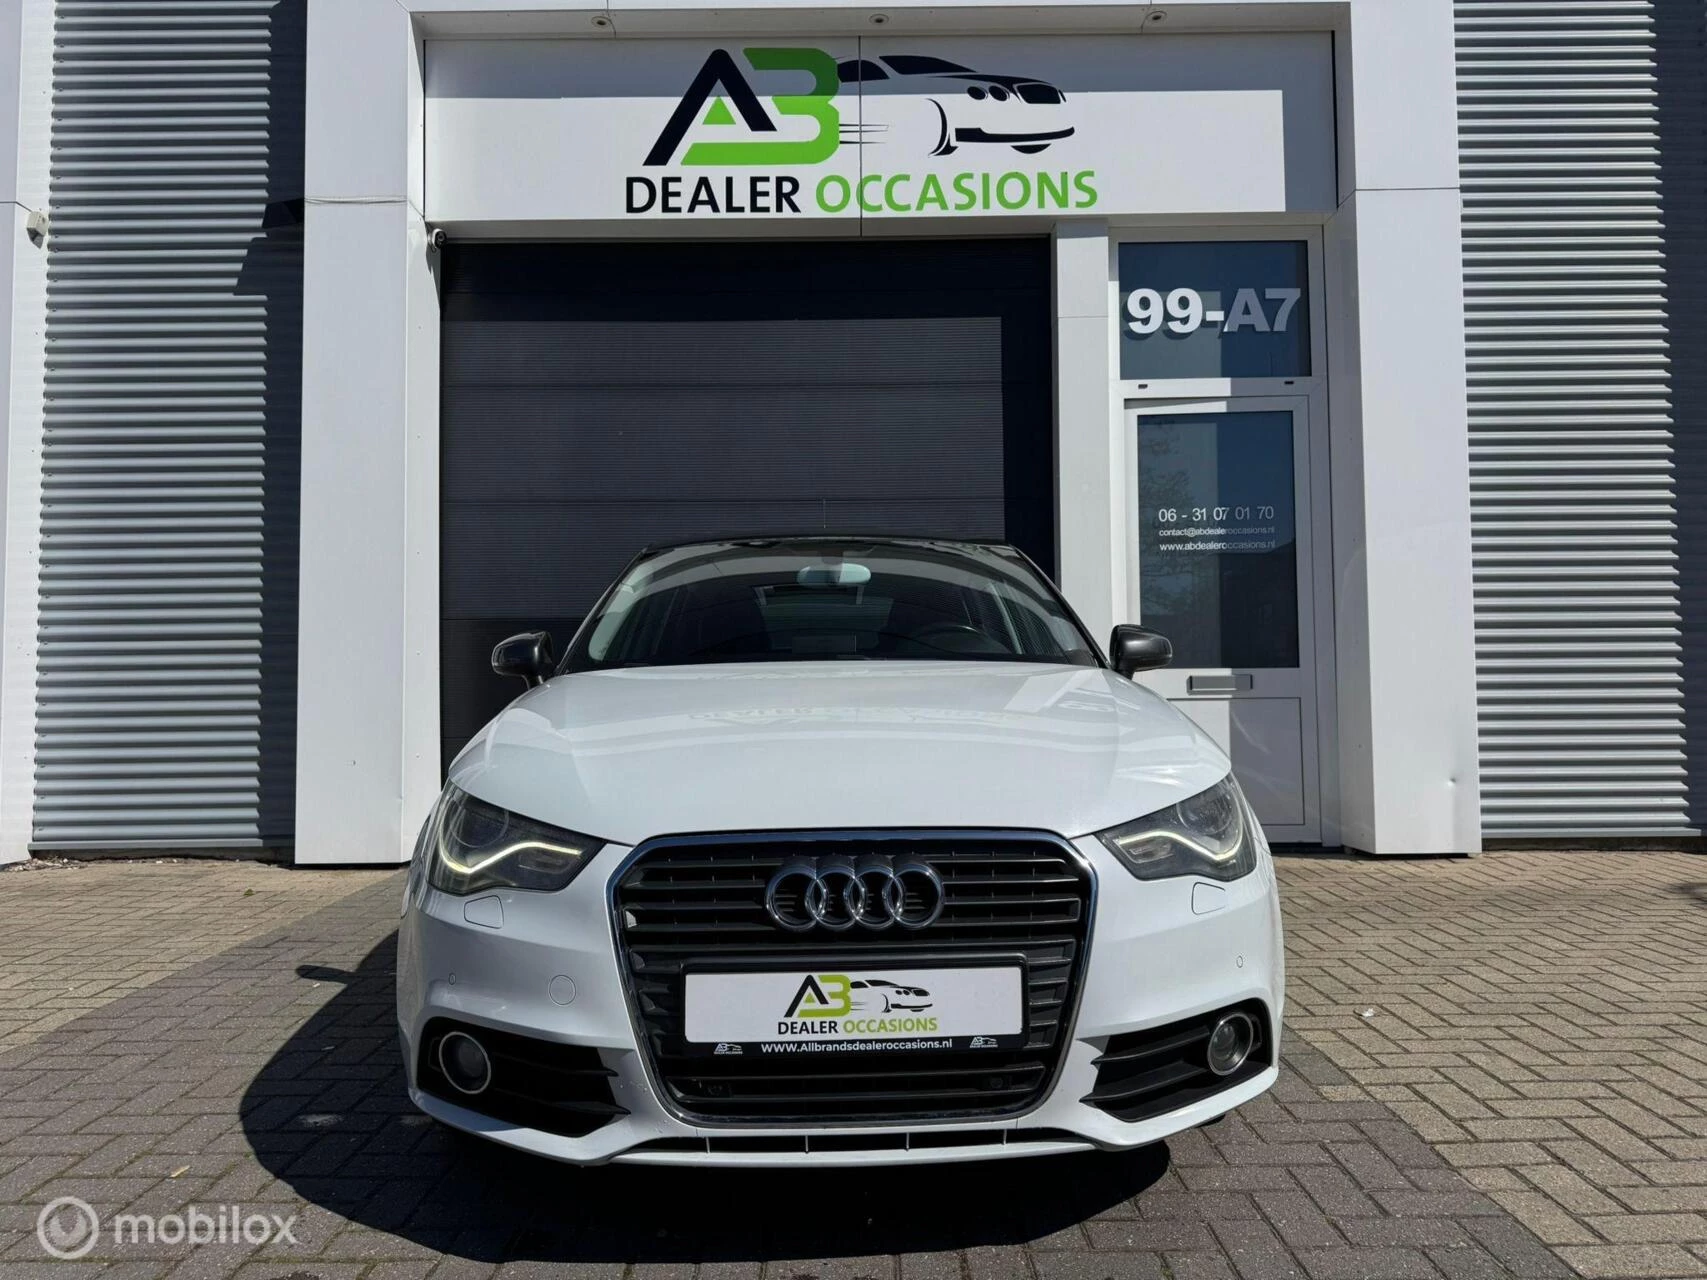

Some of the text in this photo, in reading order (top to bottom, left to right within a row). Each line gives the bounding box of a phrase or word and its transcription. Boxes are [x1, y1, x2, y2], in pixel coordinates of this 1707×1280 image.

[625, 170, 1099, 214] DEALER OCCASIONS
[1126, 287, 1301, 334] 99-A7
[1158, 508, 1177, 522] 06
[1191, 507, 1207, 521] 31
[1213, 507, 1230, 521] 07
[1235, 506, 1250, 520] 01
[1257, 505, 1275, 520] 70
[1158, 526, 1275, 538] contact@abdealeroccasions.nl
[1159, 540, 1276, 551] www.abdealeroccasions.nl
[777, 1017, 938, 1035] DEALER OCCASIONS
[760, 1038, 953, 1054] WWW.Allbrandsdealeroccasions.nl
